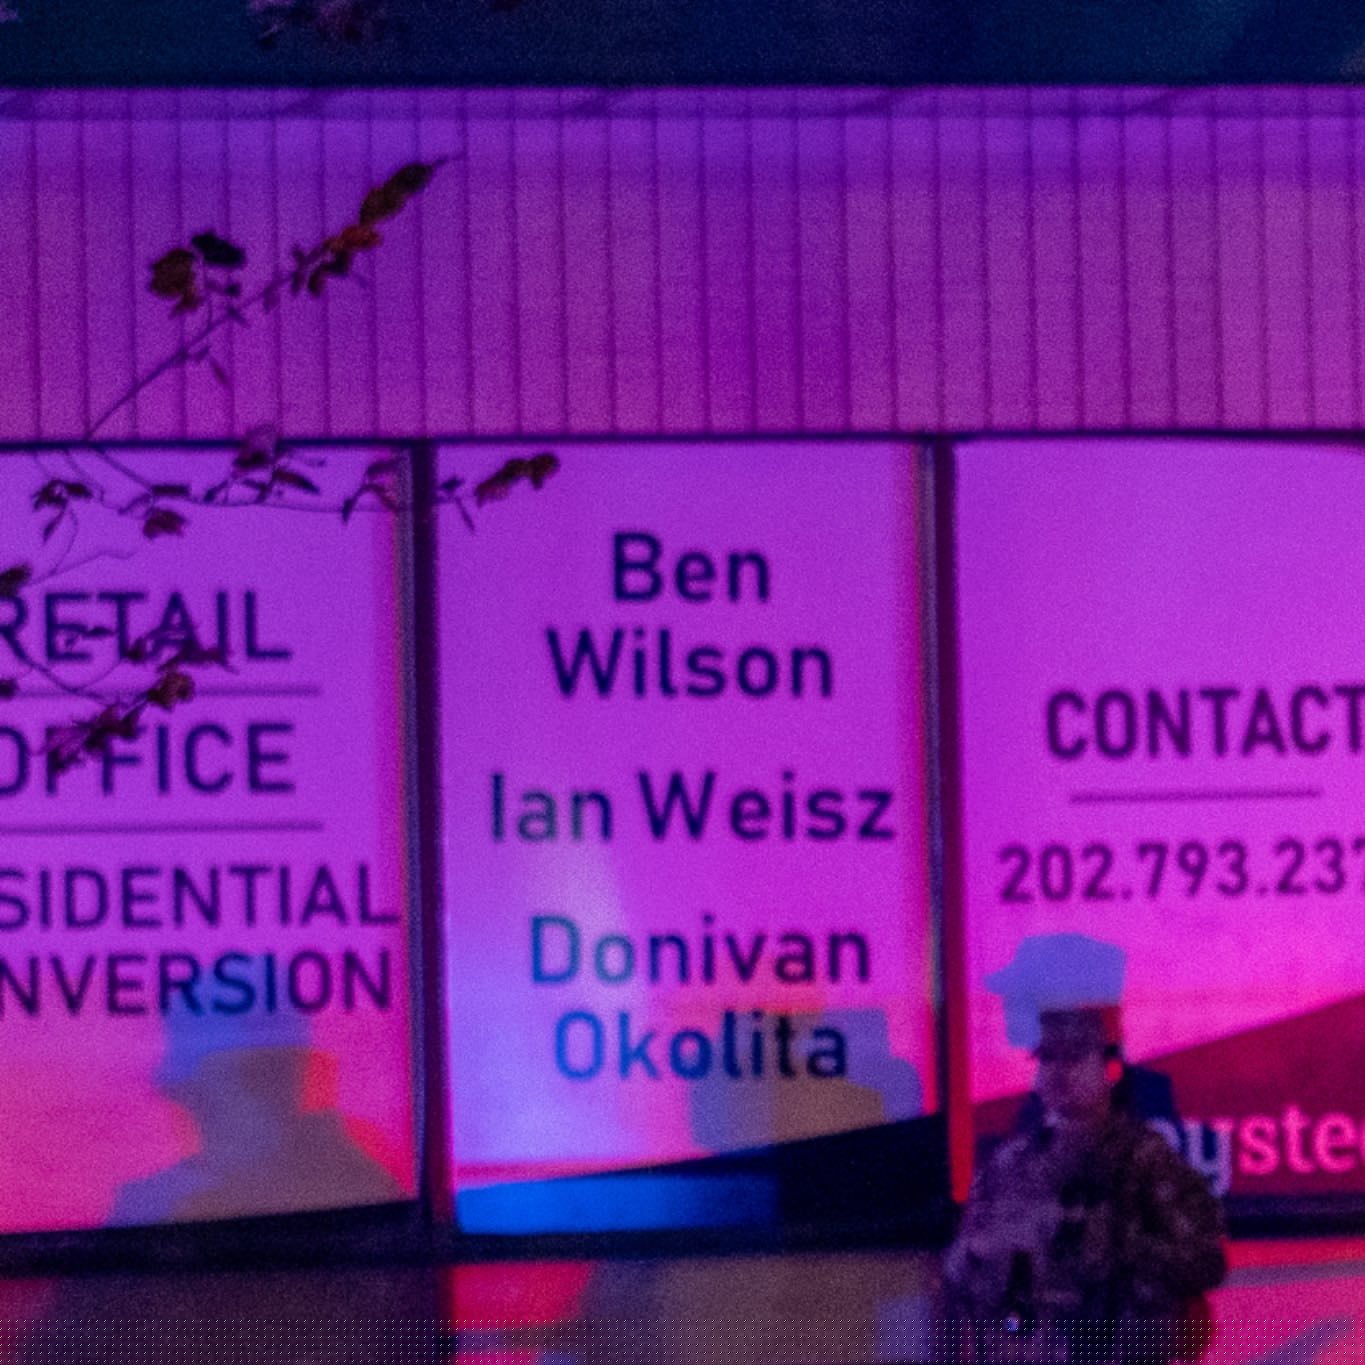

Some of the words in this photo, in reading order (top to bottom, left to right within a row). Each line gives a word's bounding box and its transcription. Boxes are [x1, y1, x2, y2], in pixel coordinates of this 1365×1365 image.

[611, 531, 772, 603] Ben
[548, 626, 834, 699] Wilson
[490, 772, 611, 842] Ian
[640, 770, 896, 842] Weisz
[530, 914, 870, 985] Donivan
[554, 1010, 850, 1079] Okolita
